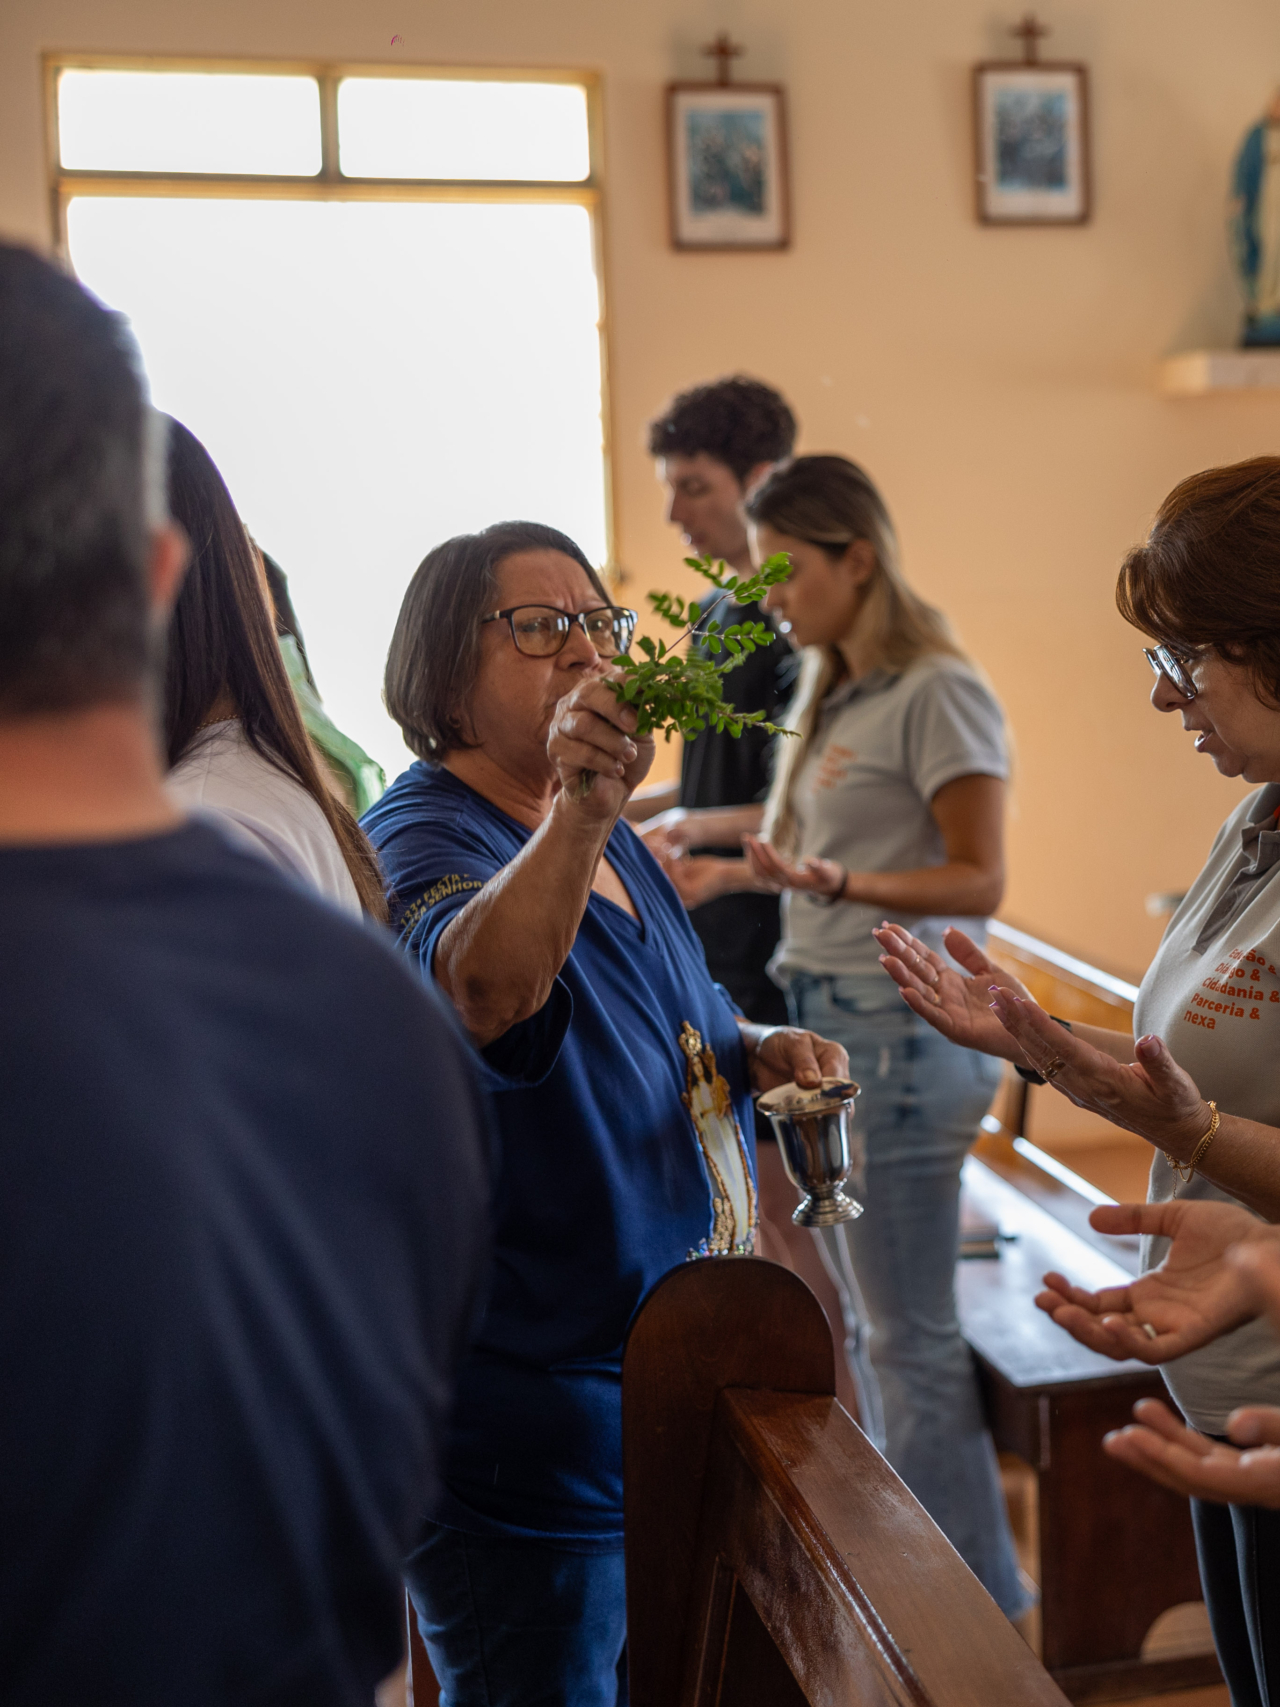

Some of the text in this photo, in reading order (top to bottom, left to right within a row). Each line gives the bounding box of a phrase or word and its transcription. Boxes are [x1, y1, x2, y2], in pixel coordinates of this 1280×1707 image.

[423, 873, 461, 903] FESTA
[428, 880, 488, 908] SENHOR
[1250, 968, 1261, 982] &
[1202, 976, 1280, 1003] Cidadania &
[1183, 1009, 1216, 1030] nexa
[1190, 992, 1261, 1020] Parceria &
